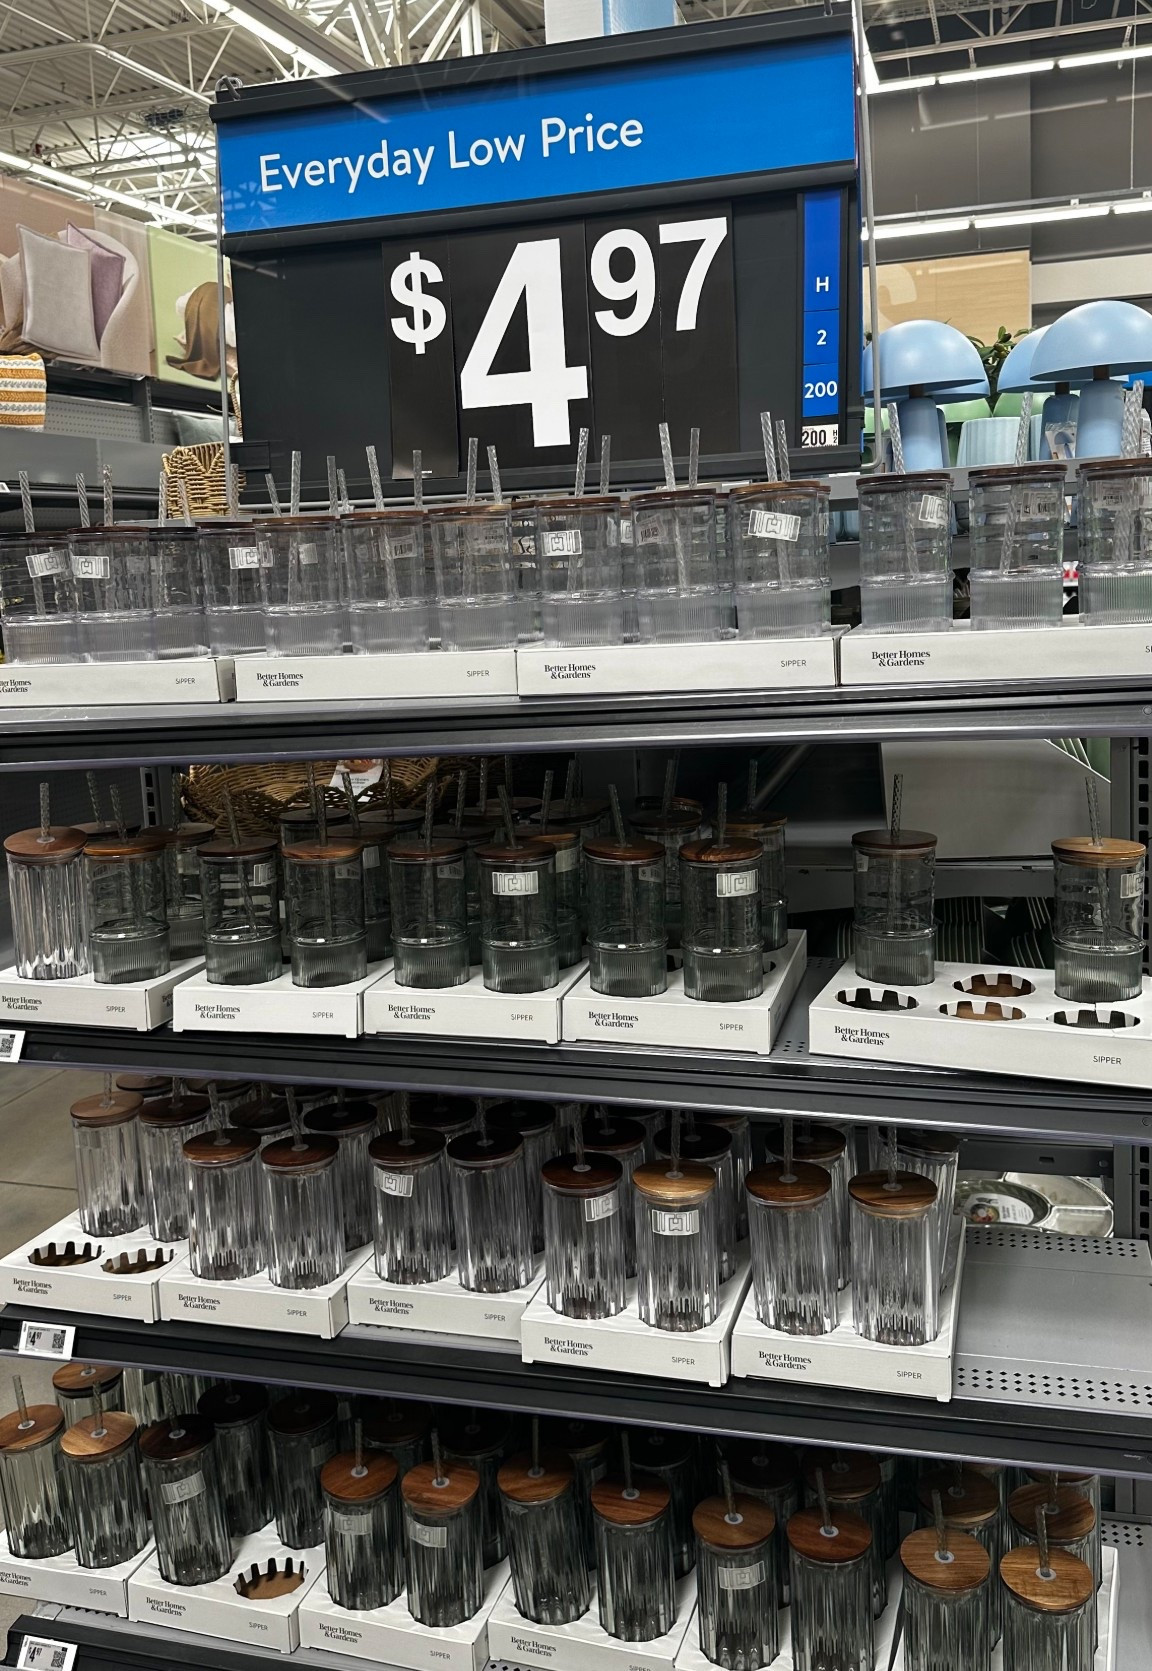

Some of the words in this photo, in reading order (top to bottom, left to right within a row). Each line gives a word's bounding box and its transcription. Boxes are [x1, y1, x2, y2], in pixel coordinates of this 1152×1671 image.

[260, 140, 434, 193] Everyday
[448, 131, 525, 169] Low
[541, 112, 643, 157] Price
[816, 277, 829, 292] H
[816, 330, 826, 345] 2
[804, 381, 837, 398] 200
[802, 430, 826, 446] 200
[872, 651, 898, 660] Better
[899, 650, 930, 658] Homes
[544, 664, 568, 672] Better
[568, 663, 596, 671] Homes
[780, 659, 807, 668] SIPPER
[256, 672, 278, 680] Better
[278, 672, 303, 680] Homes
[2, 995, 20, 1003] Better
[20, 996, 42, 1005] Homes
[195, 1004, 216, 1012] Better
[216, 1004, 240, 1013] Homes
[388, 1004, 409, 1012] Better
[409, 1005, 436, 1013] Homes
[312, 1011, 334, 1019] SIPPER
[510, 1013, 534, 1021] SIPPER
[588, 1011, 611, 1020] Better
[611, 1012, 639, 1021] Homes
[719, 1023, 744, 1031] SIPPER
[834, 1026, 859, 1036] Better
[860, 1028, 890, 1039] Homes
[1093, 1055, 1122, 1065] SIPPER
[13, 1278, 30, 1286] Better
[31, 1280, 52, 1289] Homes
[178, 1293, 197, 1302] Better
[197, 1296, 220, 1305] Homes
[369, 1298, 389, 1306] Better
[389, 1299, 414, 1309] Homes
[484, 1313, 506, 1321] SIPPER
[544, 1336, 566, 1347] Better
[566, 1339, 593, 1350] Homes
[671, 1356, 696, 1365] SIPPER
[758, 1350, 782, 1360] Better
[783, 1353, 812, 1364] Homes
[896, 1370, 922, 1379] SIPPER
[11, 1573, 32, 1581] Homes
[146, 1597, 164, 1606] Better
[164, 1600, 187, 1611] Homes
[319, 1622, 339, 1632] Better
[339, 1626, 363, 1638] Homes
[511, 1636, 532, 1646] Better
[532, 1641, 557, 1652] Homes
[430, 1650, 451, 1660] SIPPER
